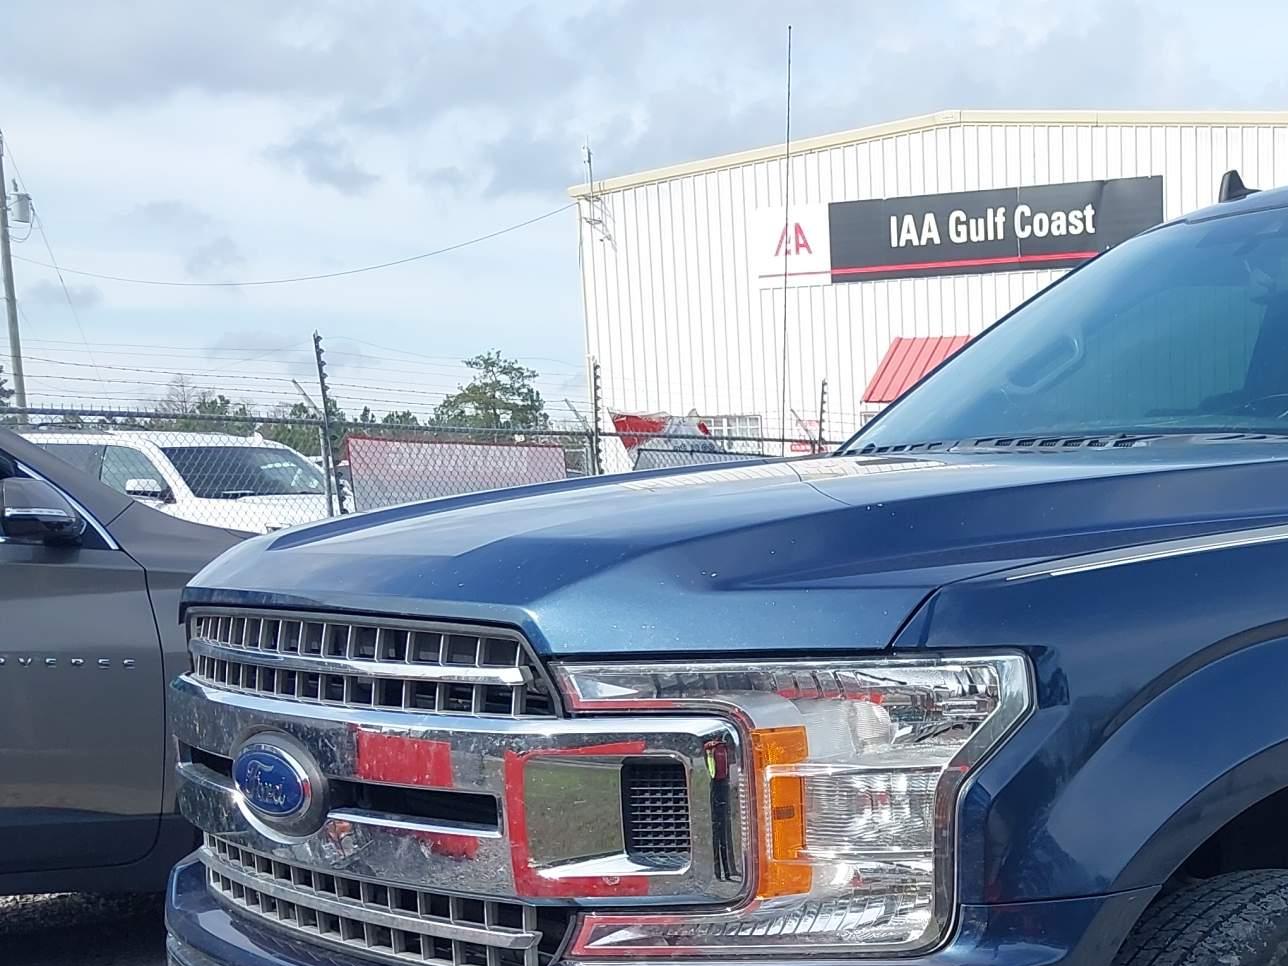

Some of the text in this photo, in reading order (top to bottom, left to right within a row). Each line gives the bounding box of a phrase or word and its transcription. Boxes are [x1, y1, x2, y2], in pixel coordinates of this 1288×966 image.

[890, 202, 1096, 248] IAA Gulf Coast
[244, 759, 288, 806] Ford
